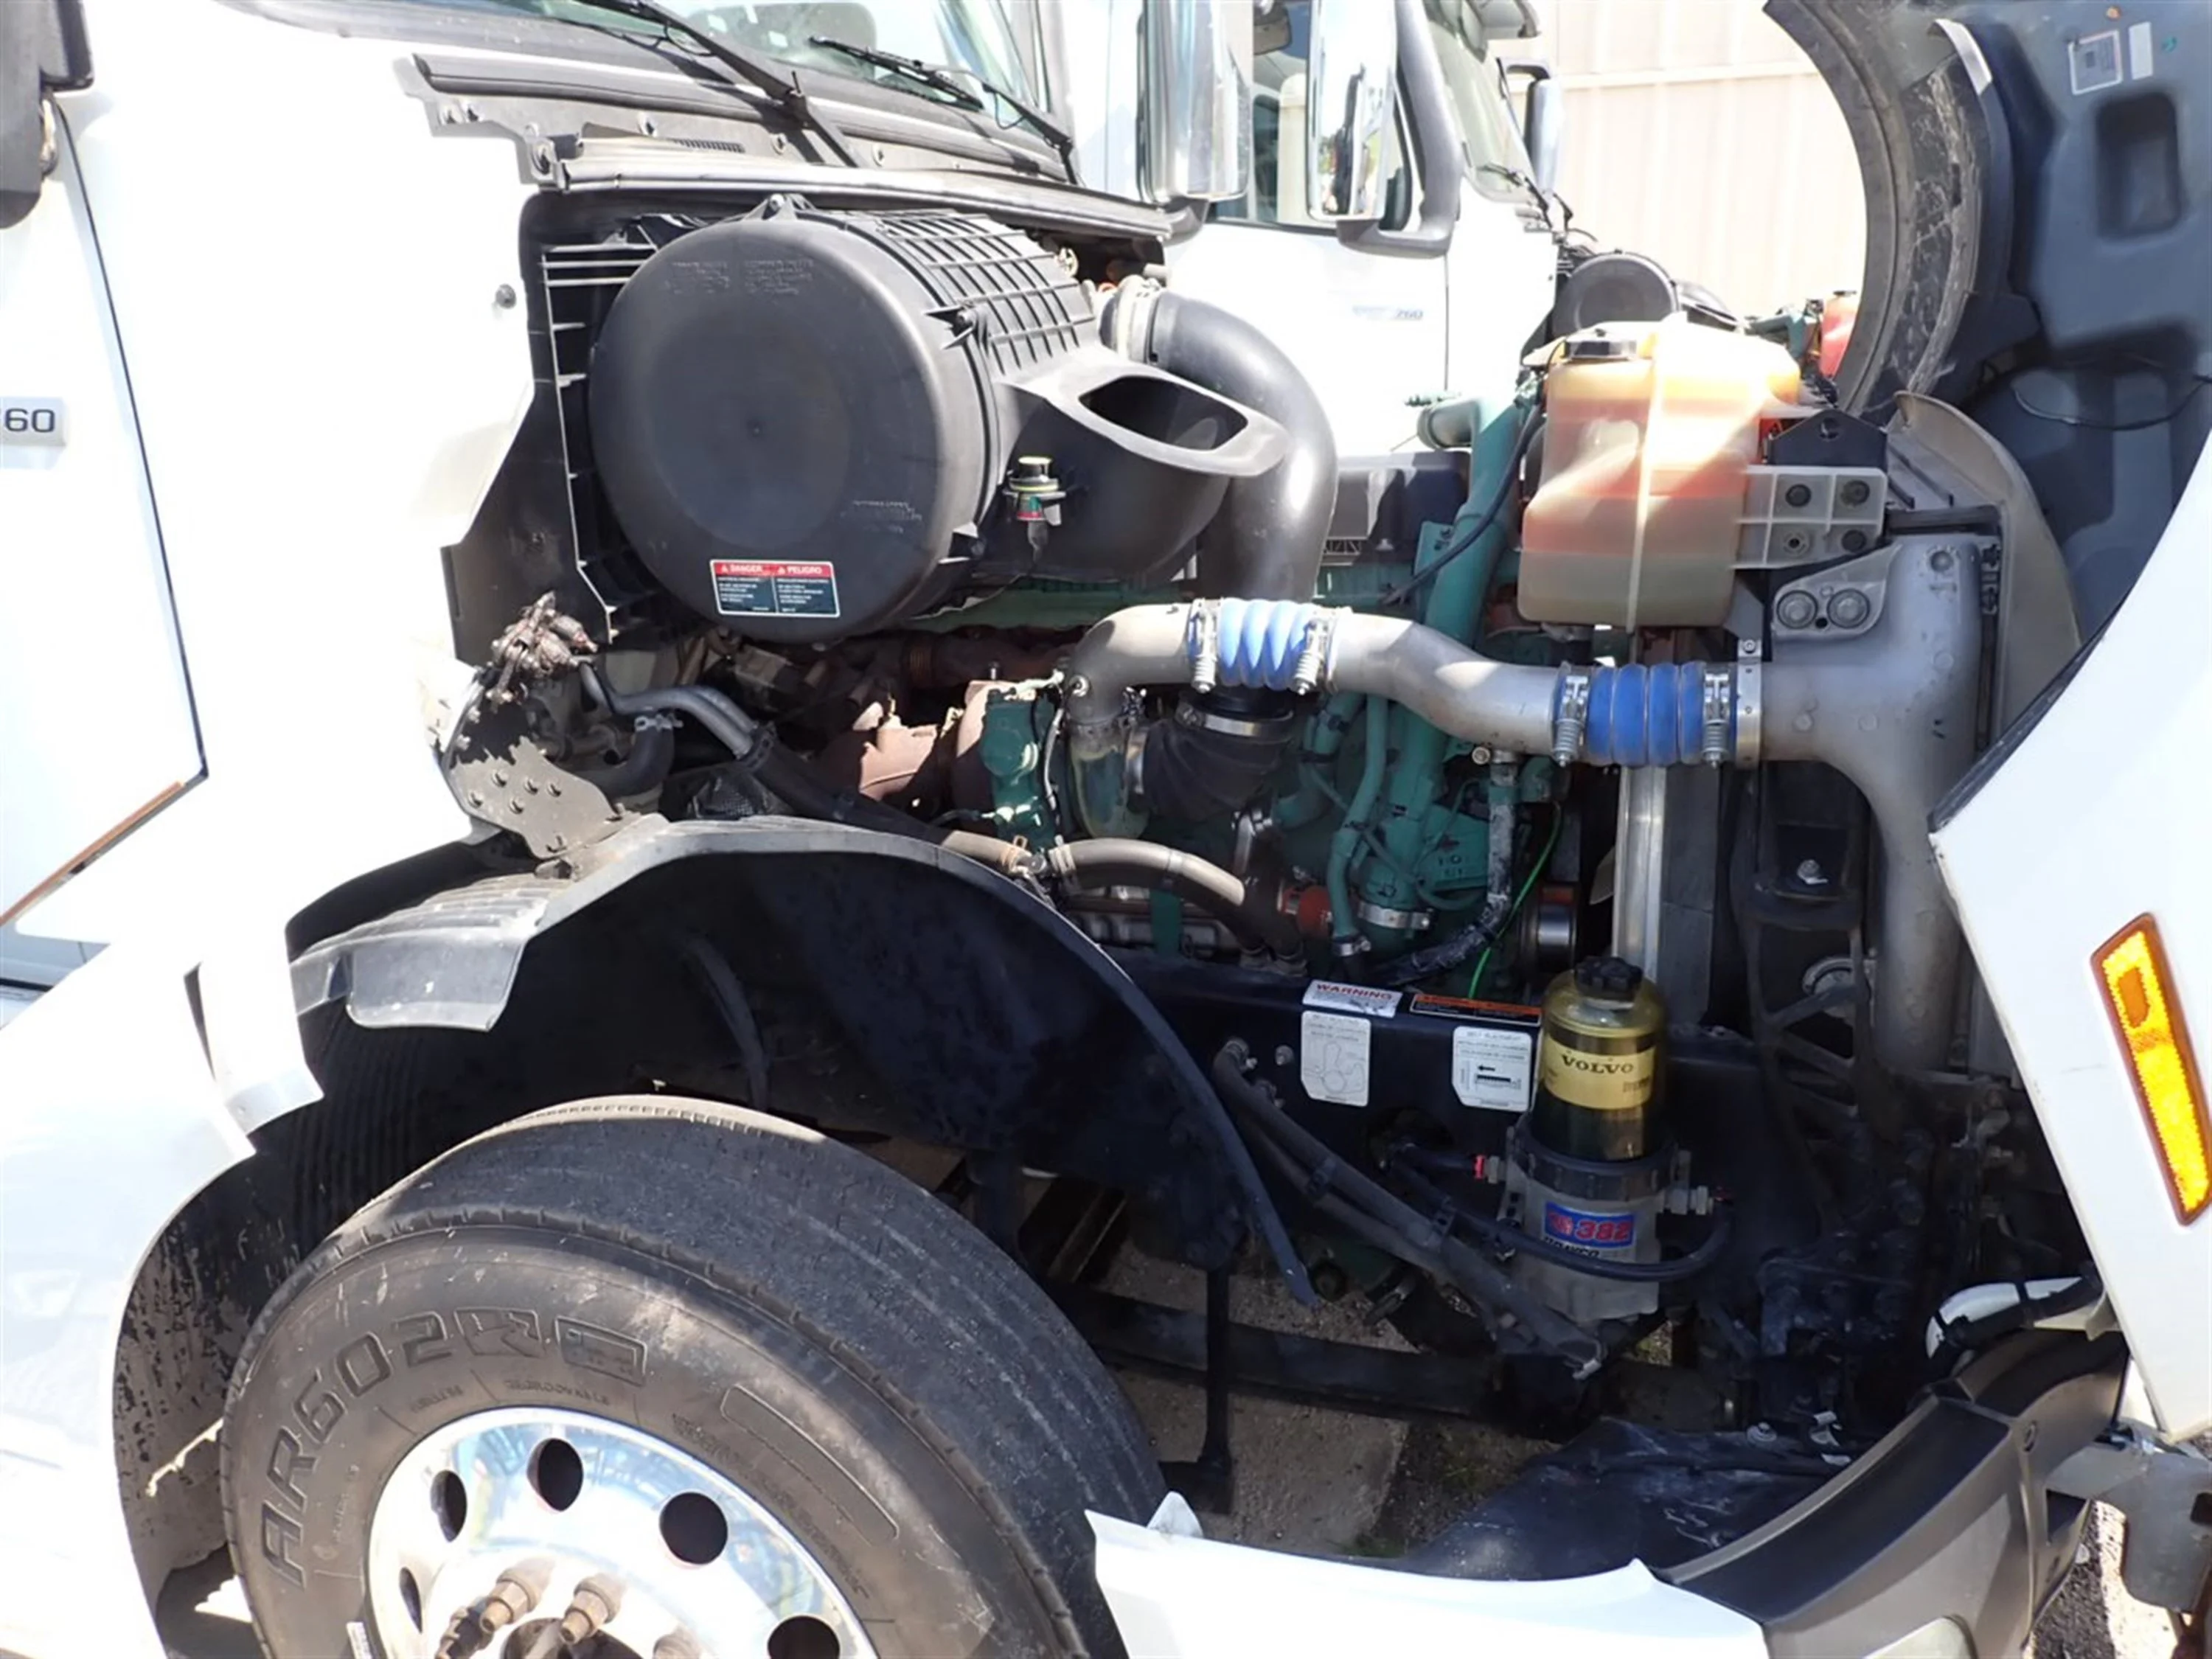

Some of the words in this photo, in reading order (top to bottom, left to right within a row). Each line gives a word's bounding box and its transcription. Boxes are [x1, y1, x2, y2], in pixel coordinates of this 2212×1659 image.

[0, 408, 56, 433] 60
[730, 564, 763, 573] DANGER
[787, 566, 823, 574] PELIGRO
[1315, 983, 1392, 1001] WARNING
[1562, 1054, 1634, 1074] VOLVO
[1575, 1219, 1633, 1242] 382
